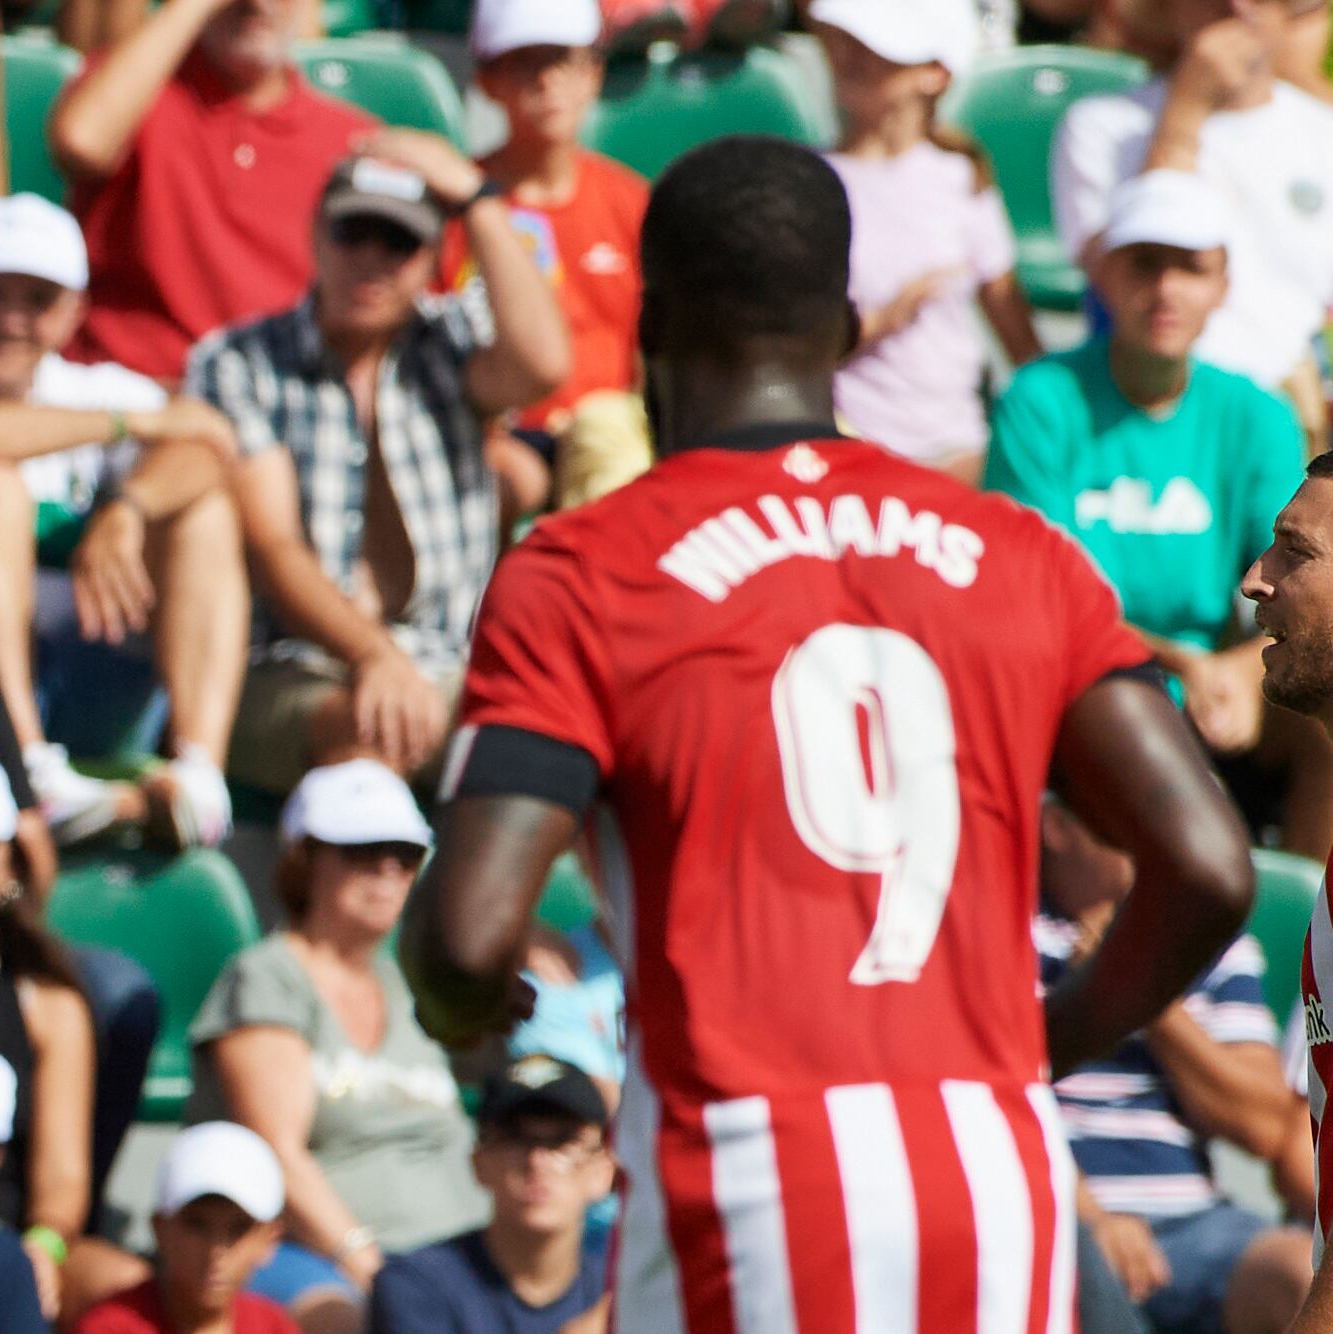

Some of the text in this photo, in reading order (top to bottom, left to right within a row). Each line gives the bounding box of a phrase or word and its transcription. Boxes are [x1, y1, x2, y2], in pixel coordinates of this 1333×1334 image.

[657, 493, 984, 603] WILLIAMS
[1075, 474, 1213, 535] FILA
[771, 622, 962, 986] 9
